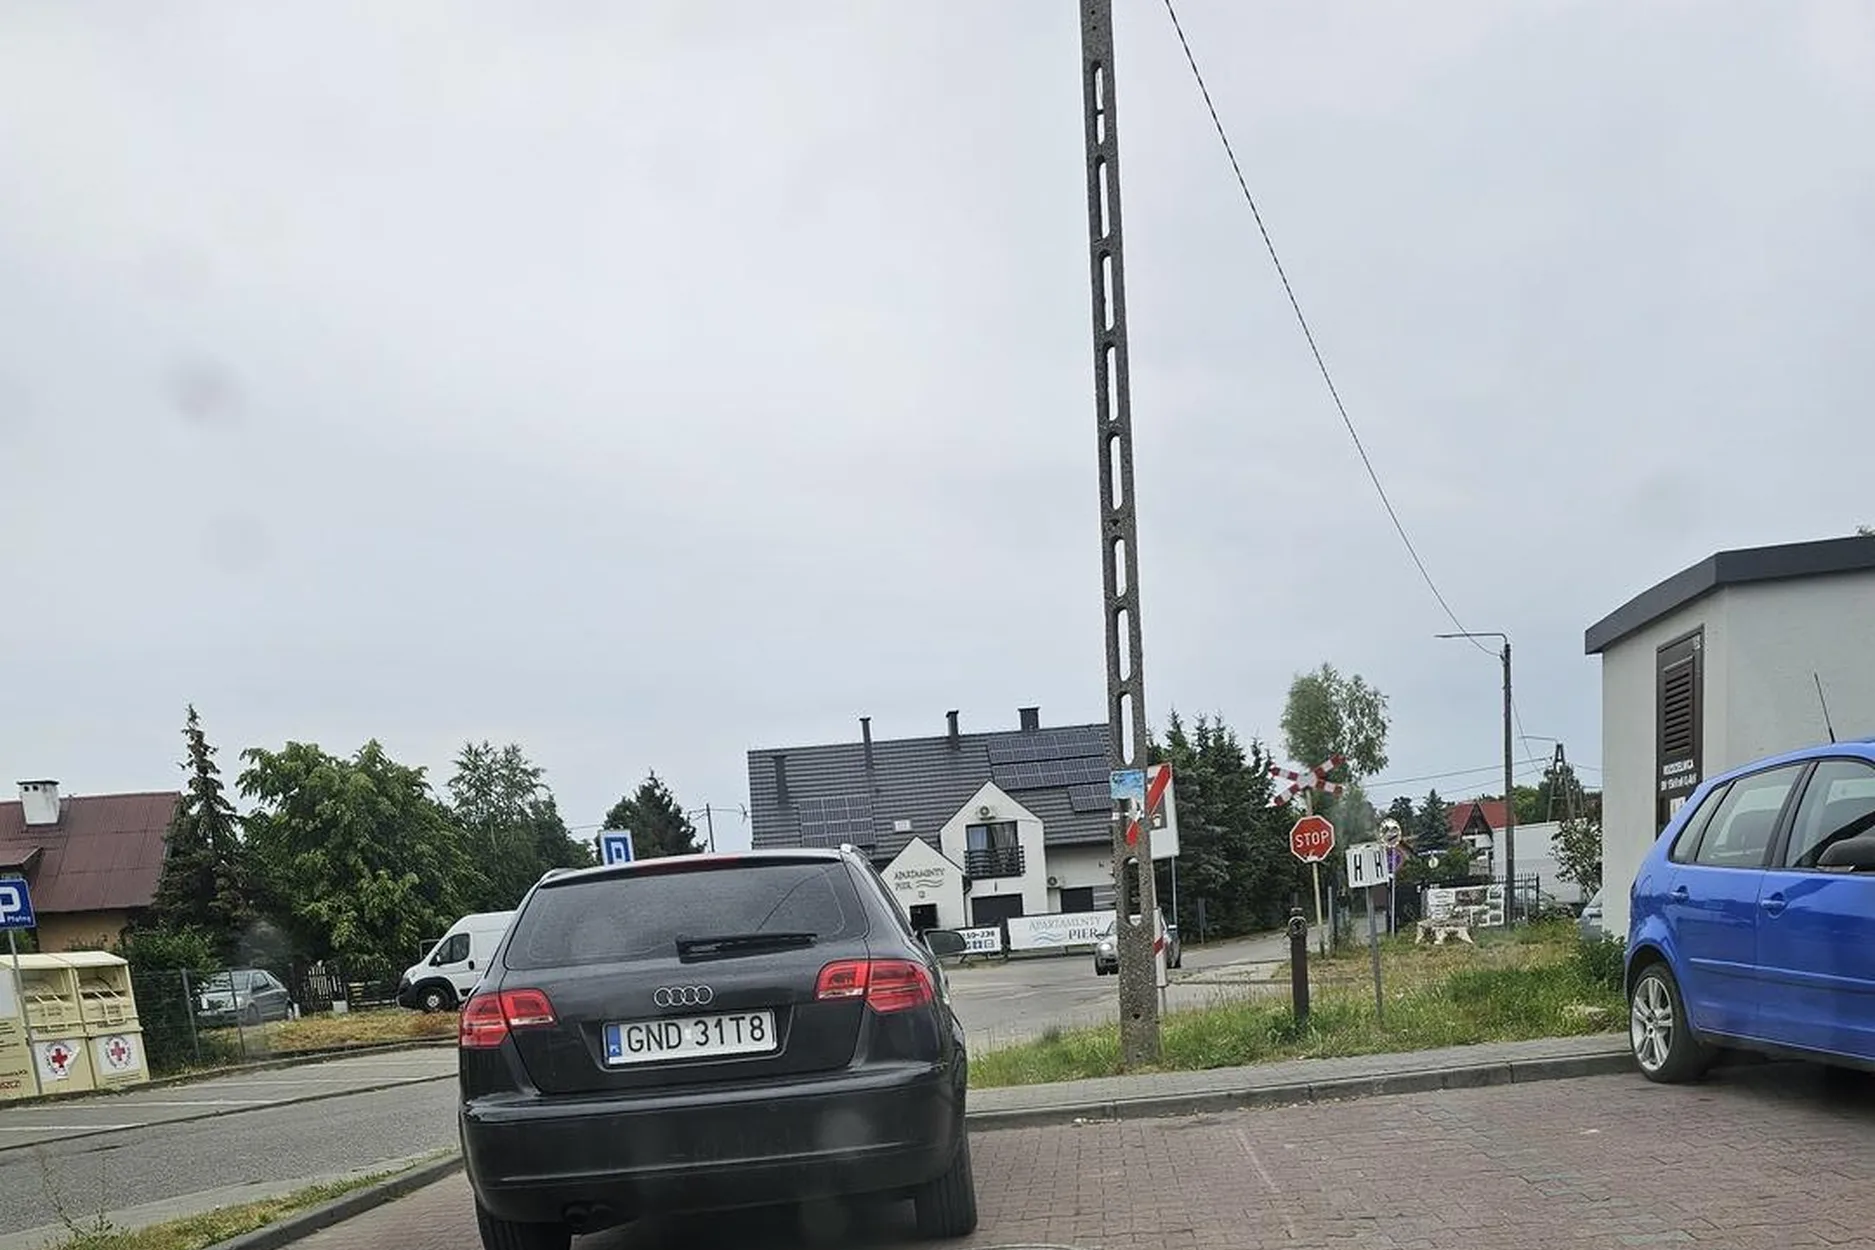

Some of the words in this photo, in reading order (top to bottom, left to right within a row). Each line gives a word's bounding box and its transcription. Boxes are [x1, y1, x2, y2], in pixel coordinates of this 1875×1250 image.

[1294, 829, 1330, 849] STOP
[0, 886, 22, 923] P
[1028, 915, 1101, 932] APARTAMENTY
[1068, 928, 1098, 941] PIER
[626, 1022, 682, 1053] GND
[694, 1015, 766, 1046] 31T8
